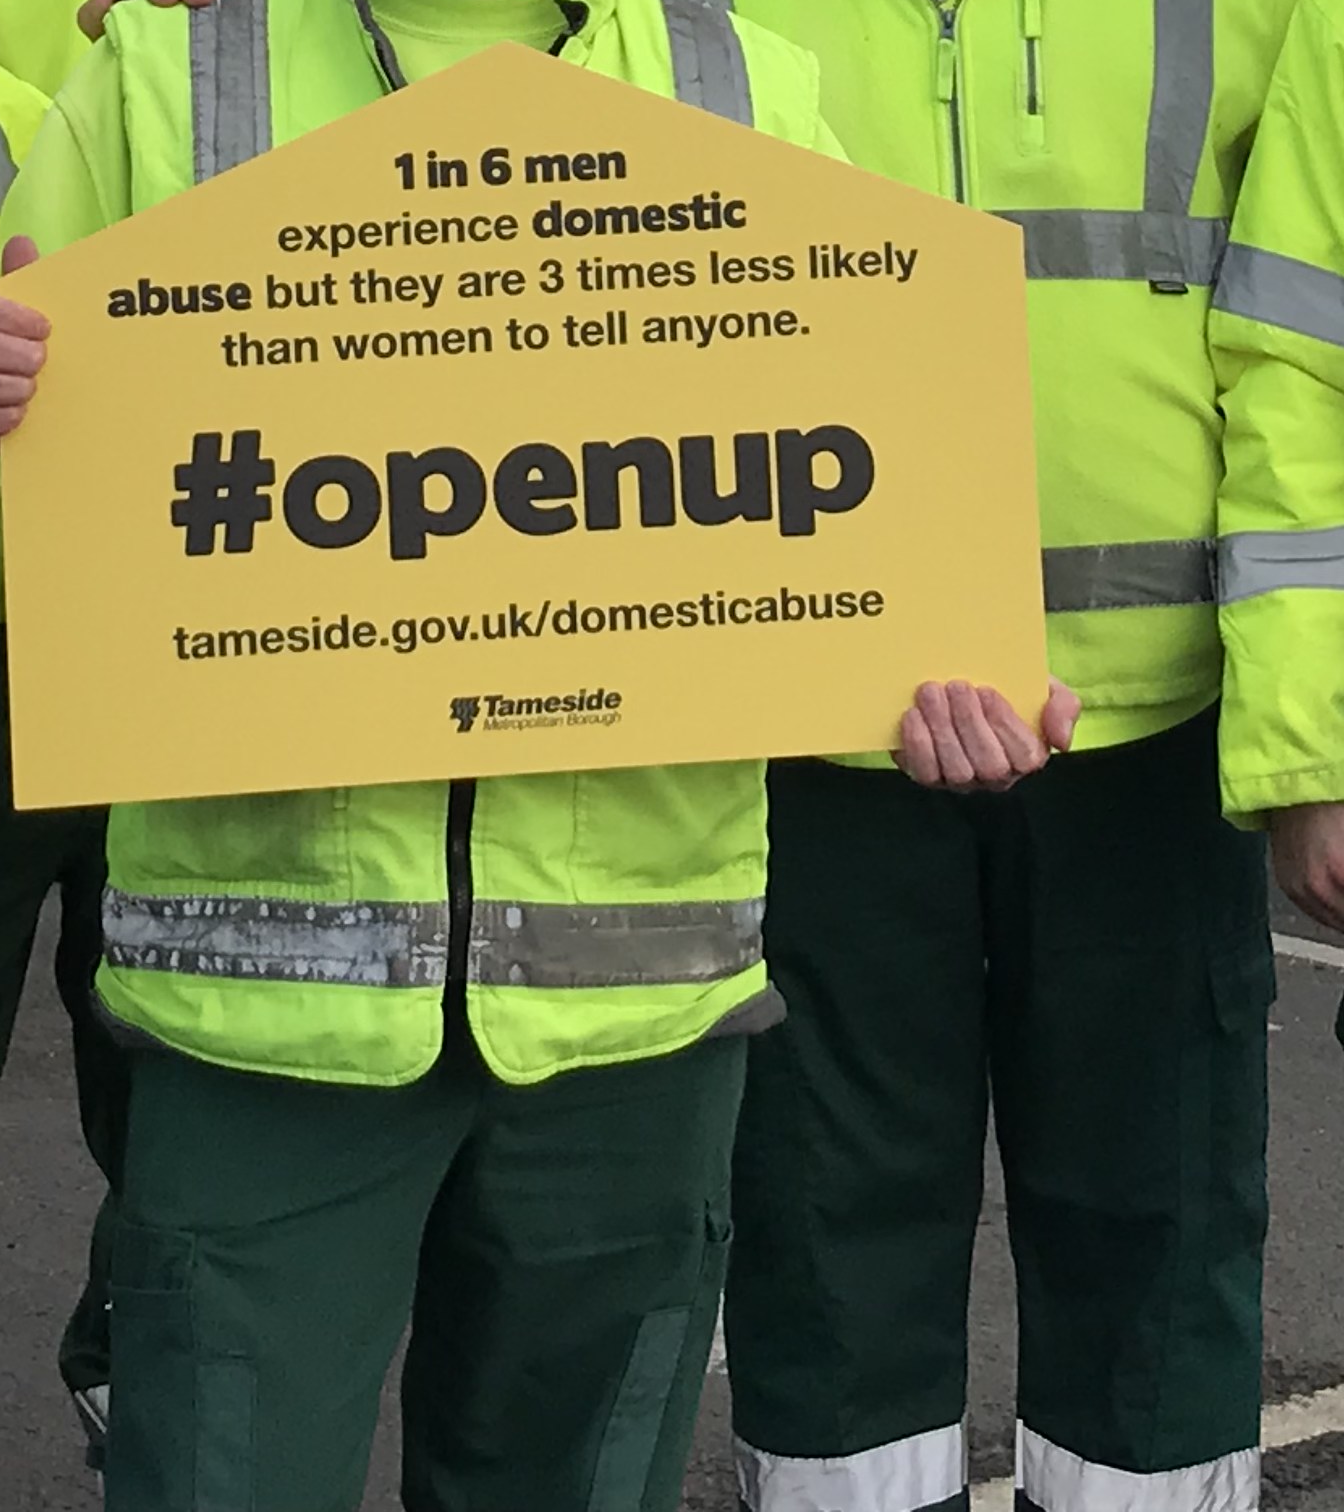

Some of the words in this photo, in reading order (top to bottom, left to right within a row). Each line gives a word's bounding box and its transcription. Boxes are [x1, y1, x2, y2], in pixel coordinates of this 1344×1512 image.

[394, 152, 416, 191] 1
[426, 150, 469, 189] in
[480, 147, 513, 187] 6
[524, 151, 627, 184] men
[277, 211, 519, 258] experience
[532, 190, 747, 239] domestic
[107, 278, 252, 319] abuse
[266, 272, 339, 310] but
[349, 268, 444, 309] they
[457, 269, 526, 299] are
[539, 258, 565, 294] 3
[575, 256, 697, 292] times
[709, 250, 796, 285] less
[808, 241, 918, 283] likely
[220, 331, 319, 368] than
[332, 326, 493, 361] women
[505, 318, 550, 351] to
[561, 310, 628, 348] tell
[642, 309, 810, 349] anyone.
[170, 424, 875, 562] #openup
[172, 586, 885, 661] tameside.gov.uk/domesticabuse
[482, 713, 563, 733] Metropolitan
[565, 710, 623, 729] Borough
[483, 687, 623, 718] Tameside
